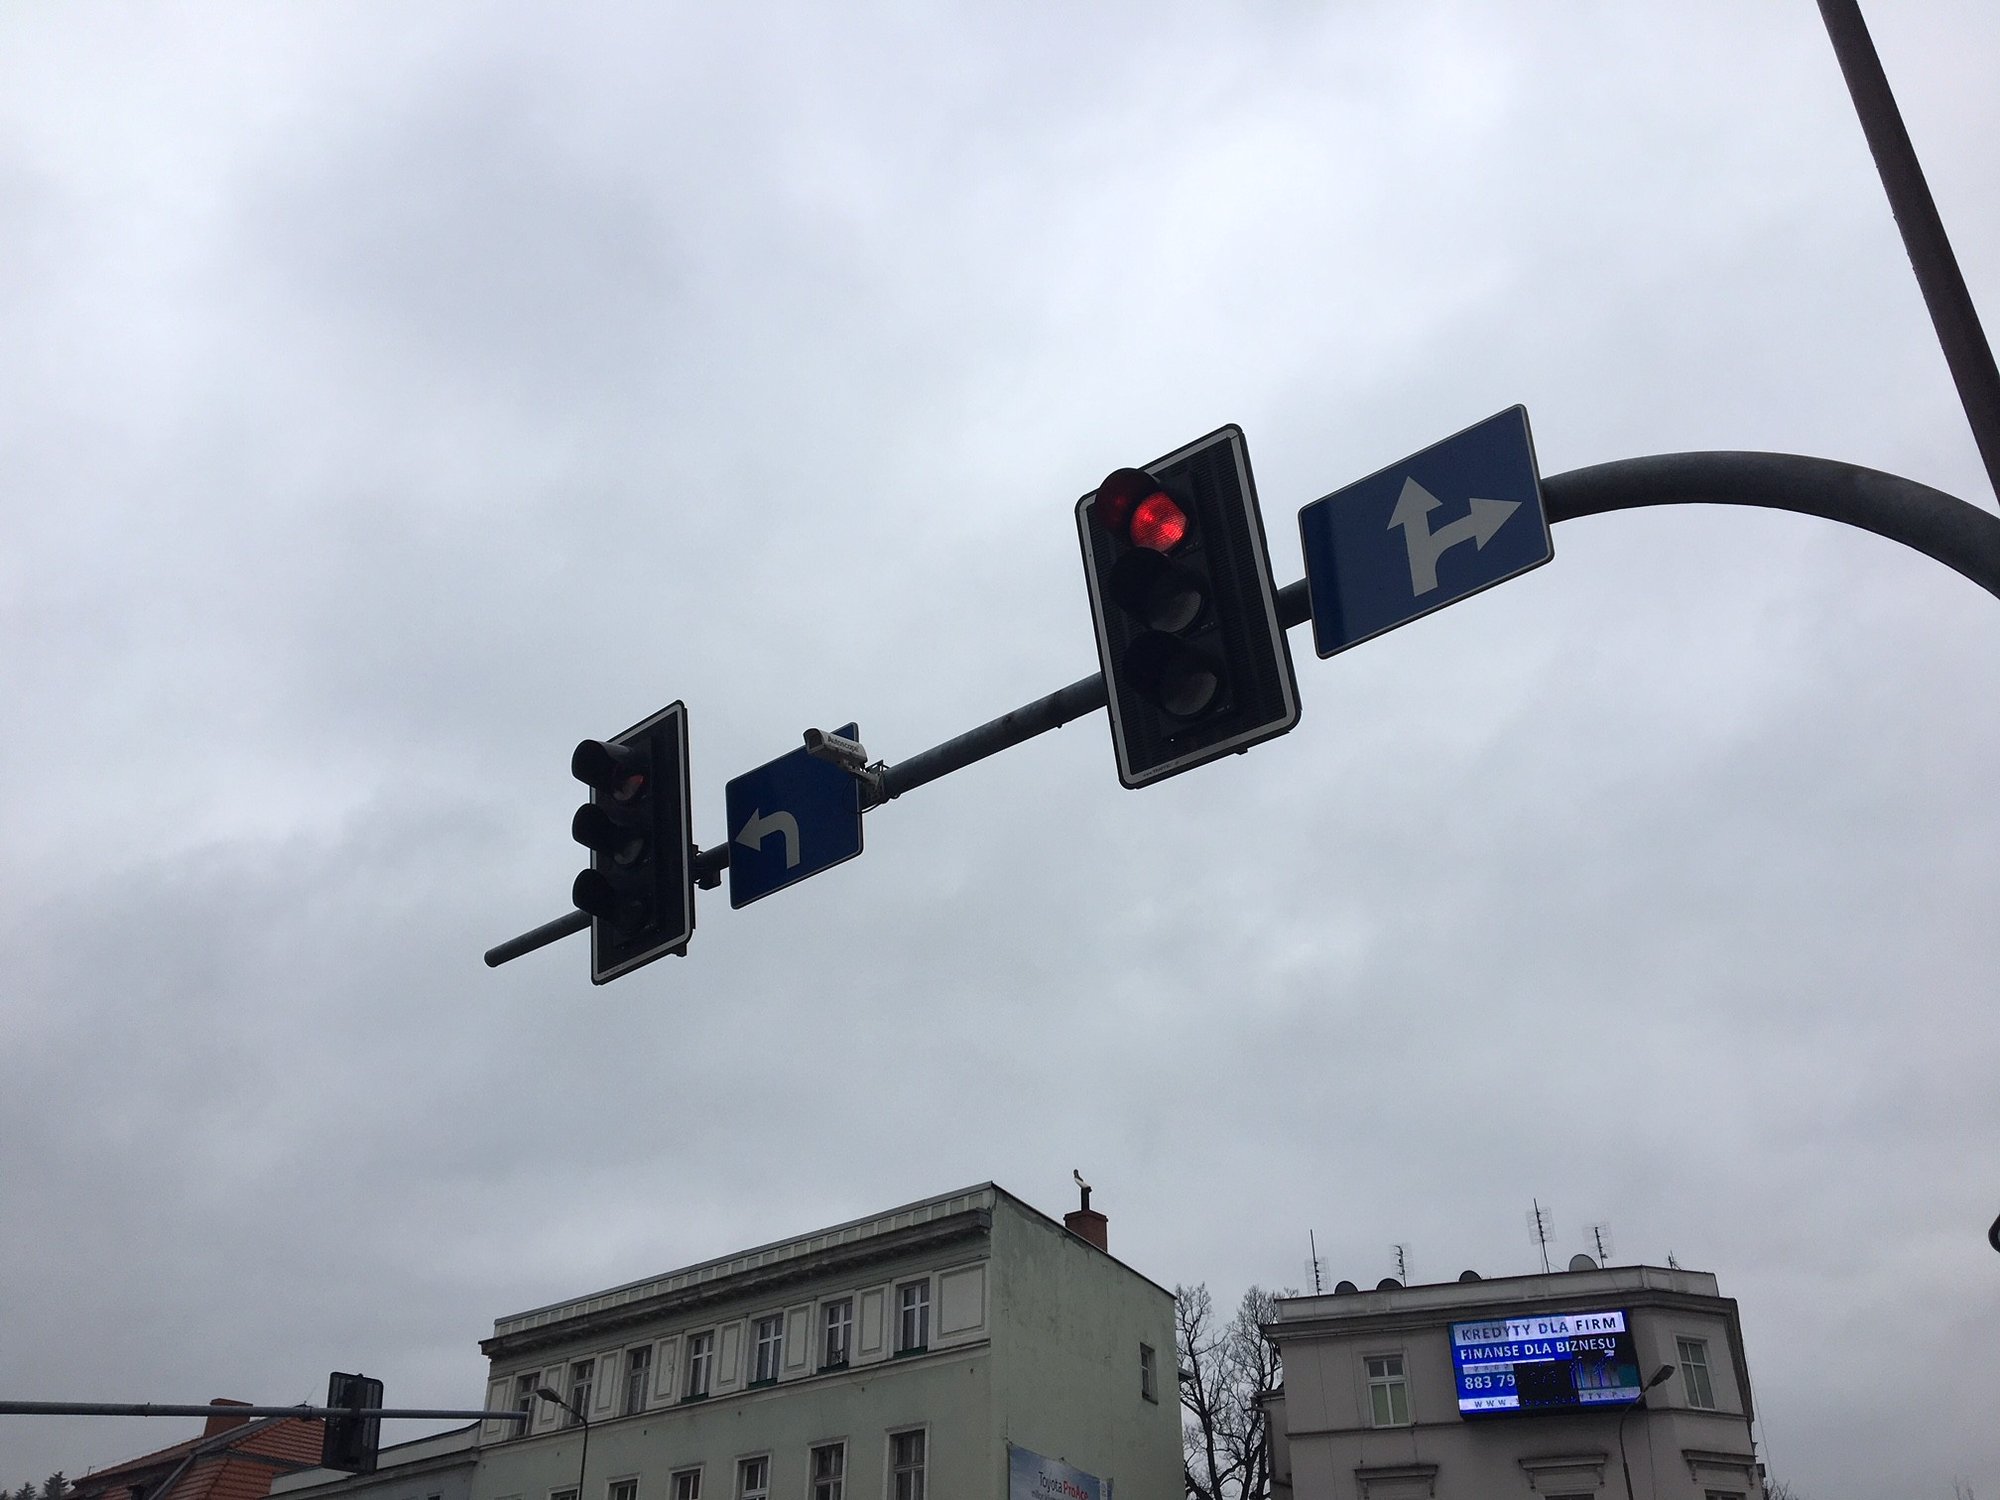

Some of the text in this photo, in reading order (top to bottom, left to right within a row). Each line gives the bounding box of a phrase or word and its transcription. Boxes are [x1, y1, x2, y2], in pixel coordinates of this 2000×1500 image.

[1462, 1317, 1616, 1341] KREDYTY DLA FIRM
[1460, 1338, 1616, 1361] FINANSE DLA BIZNESU
[1465, 1373, 1516, 1390] 883 79
[1038, 1471, 1063, 1494] Toyota
[1063, 1481, 1089, 1500] ProAce
